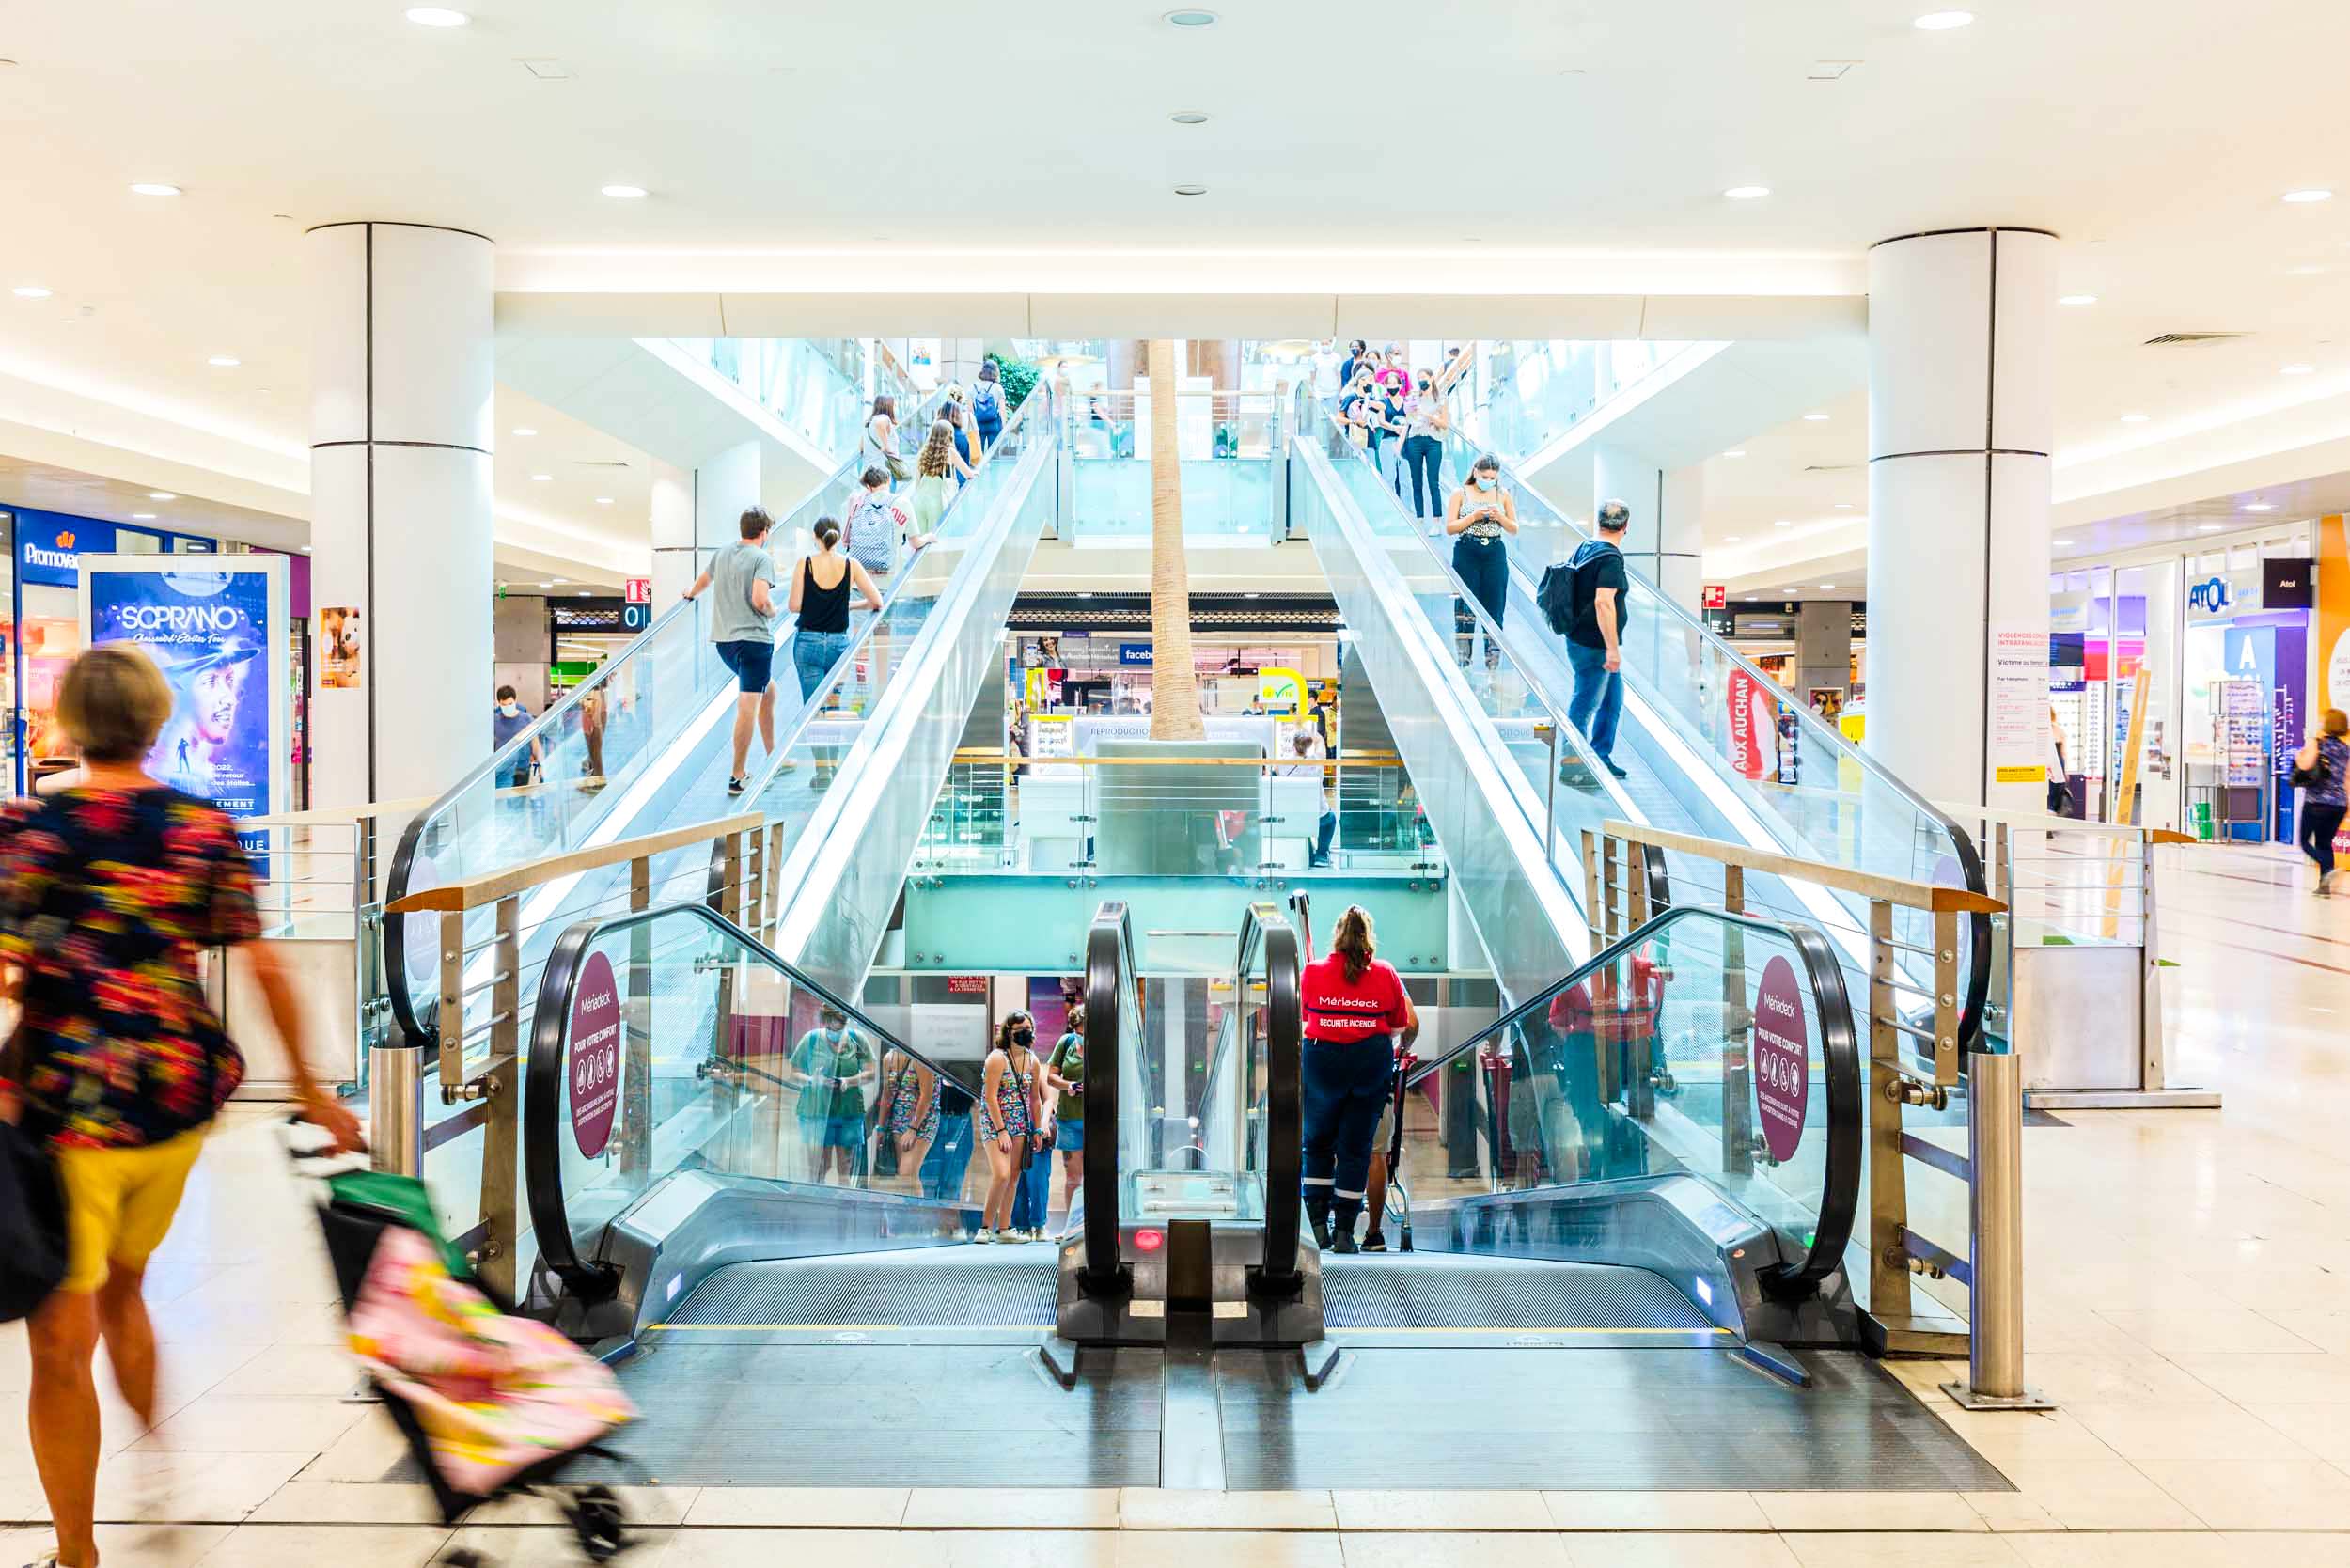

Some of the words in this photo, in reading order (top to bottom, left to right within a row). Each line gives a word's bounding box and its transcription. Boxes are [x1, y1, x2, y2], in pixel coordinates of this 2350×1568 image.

[2188, 577, 2229, 612] ATOL
[121, 605, 237, 630] SOPRANO
[1734, 678, 1748, 738] AUCHAN
[1090, 727, 1149, 738] REPRODUCTIO
[1734, 740, 1747, 772] AUX
[581, 989, 611, 1015] Mériadeck
[1319, 996, 1378, 1008] Mériadeck
[1764, 993, 1795, 1019] Mériadeck
[1320, 1018, 1348, 1027] SECURITE
[1349, 1019, 1376, 1028] INCENDIE
[574, 1039, 587, 1053] POUR
[586, 1031, 600, 1047] VOTRE
[599, 1023, 617, 1042] CONFORT
[1759, 1027, 1768, 1041] POUR
[1769, 1031, 1781, 1048] VOTRE
[1782, 1037, 1802, 1057] CONFORT
